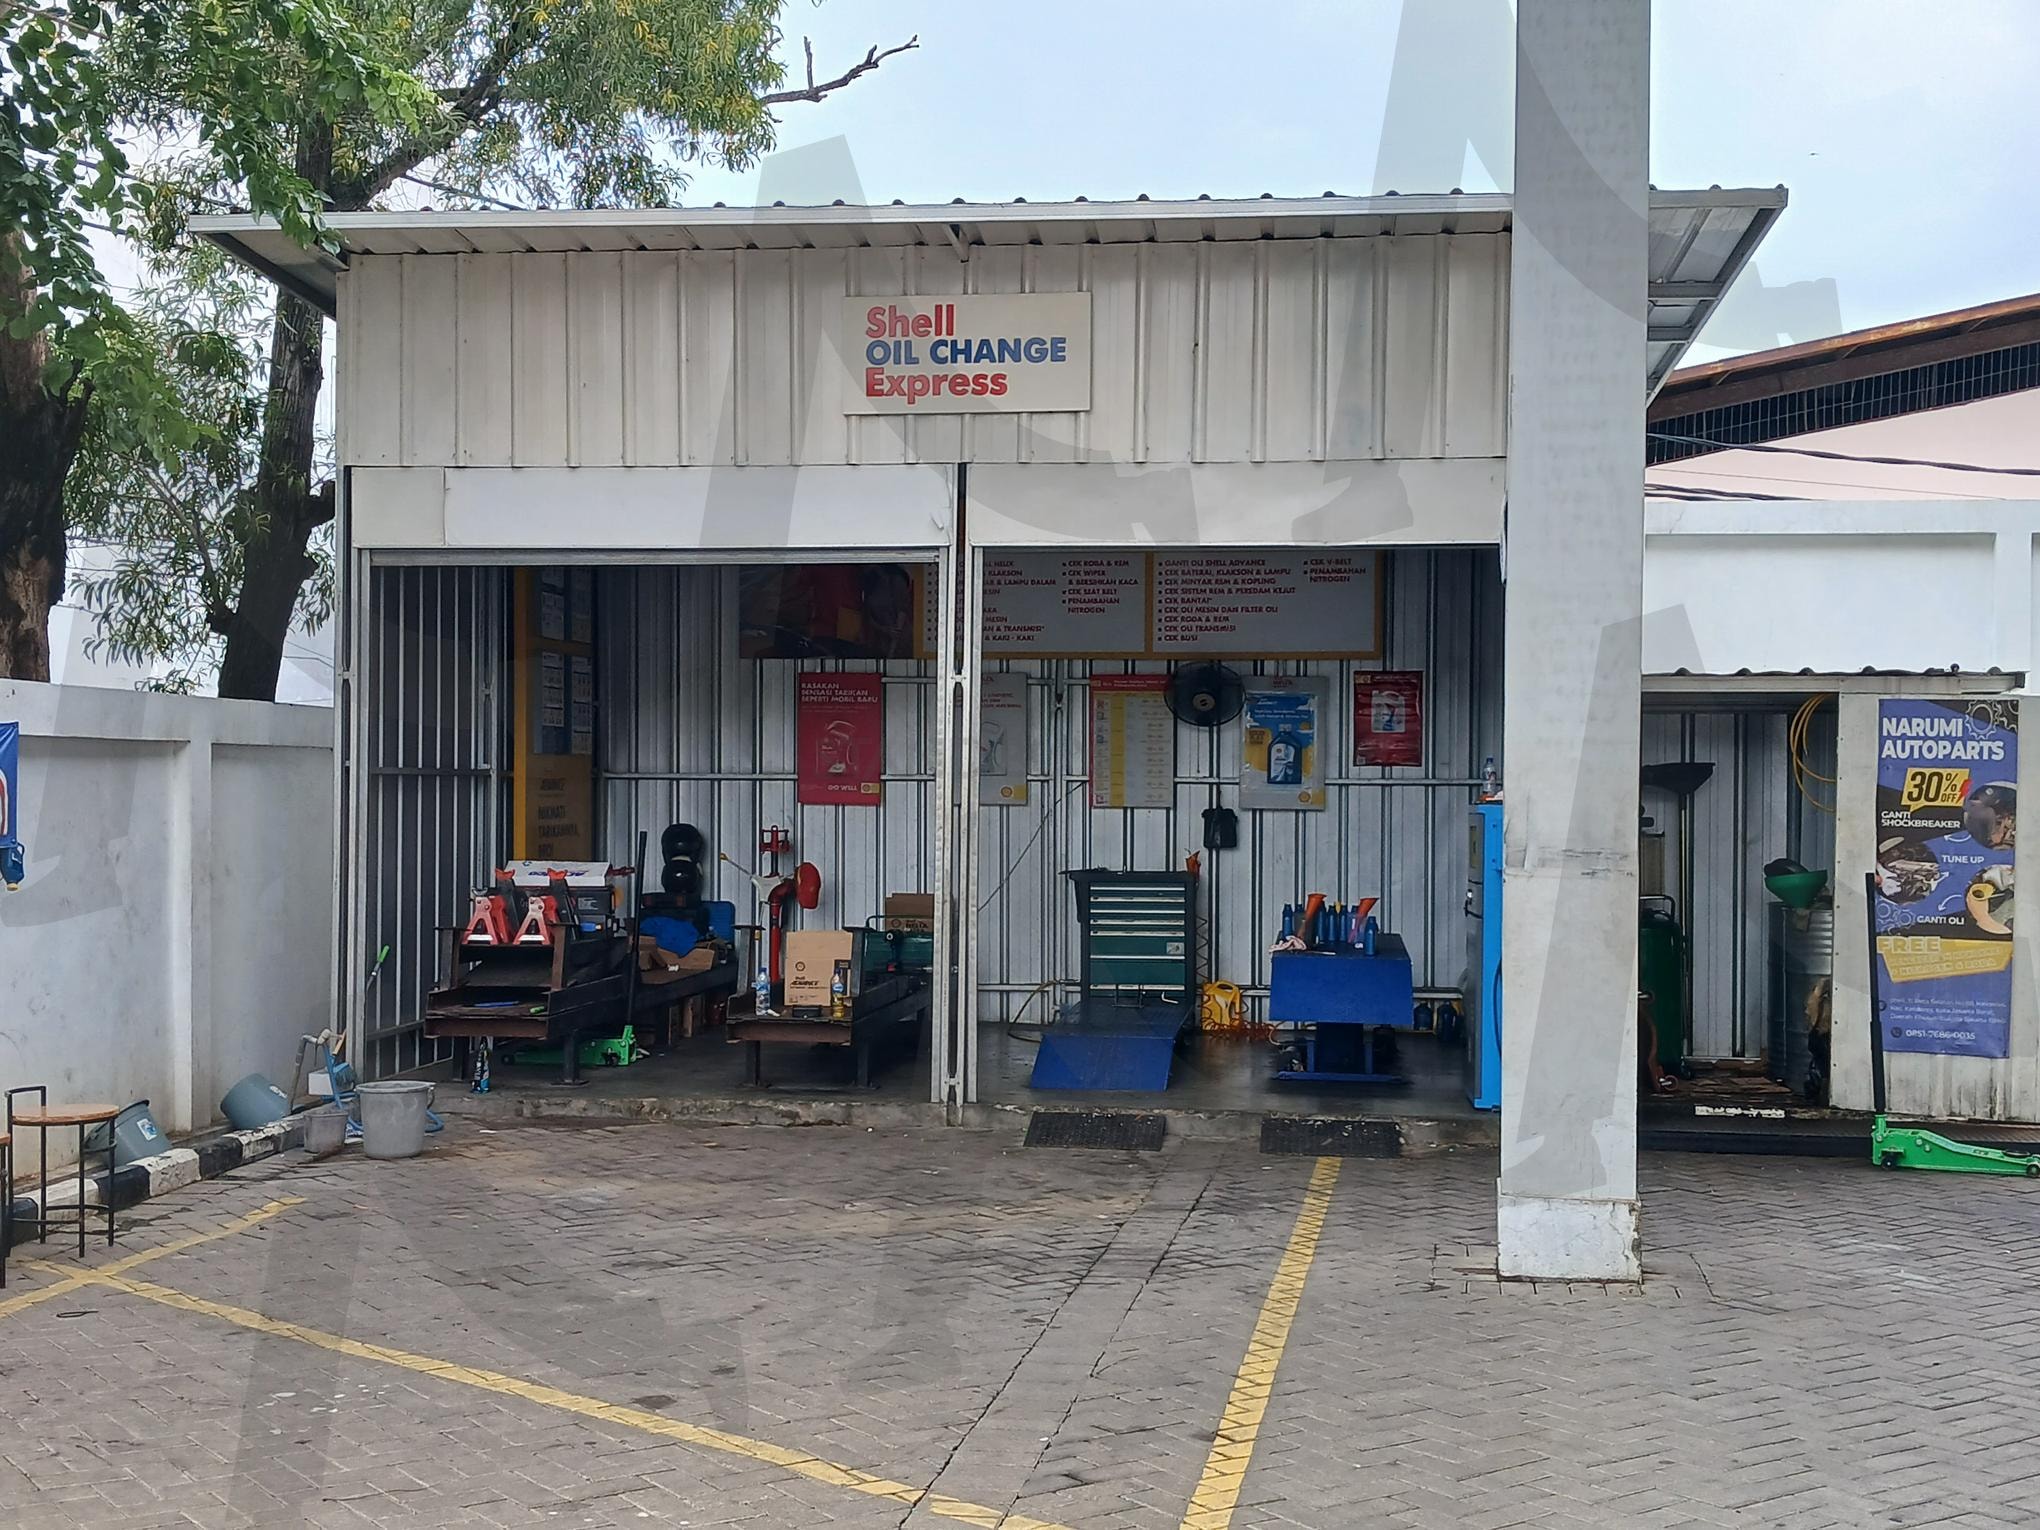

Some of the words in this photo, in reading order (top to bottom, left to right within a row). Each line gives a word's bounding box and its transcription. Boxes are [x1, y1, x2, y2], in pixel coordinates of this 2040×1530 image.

[866, 304, 955, 339] Shell
[866, 339, 920, 366] OIL
[929, 337, 1067, 365] CHANGE
[865, 367, 1008, 405] Express
[1882, 717, 1964, 737] NARUMI
[1881, 739, 2005, 761] AUTOPARTS
[1940, 793, 1958, 803] OFF
[1881, 810, 1911, 820] GANTI
[1881, 818, 1961, 829] SHOCKBREAKER
[1941, 854, 1968, 863] TUNE
[1970, 855, 1985, 864] UP
[1916, 915, 1947, 925] GANTI
[1948, 916, 1965, 926] OLI
[1877, 937, 1940, 953] FREE
